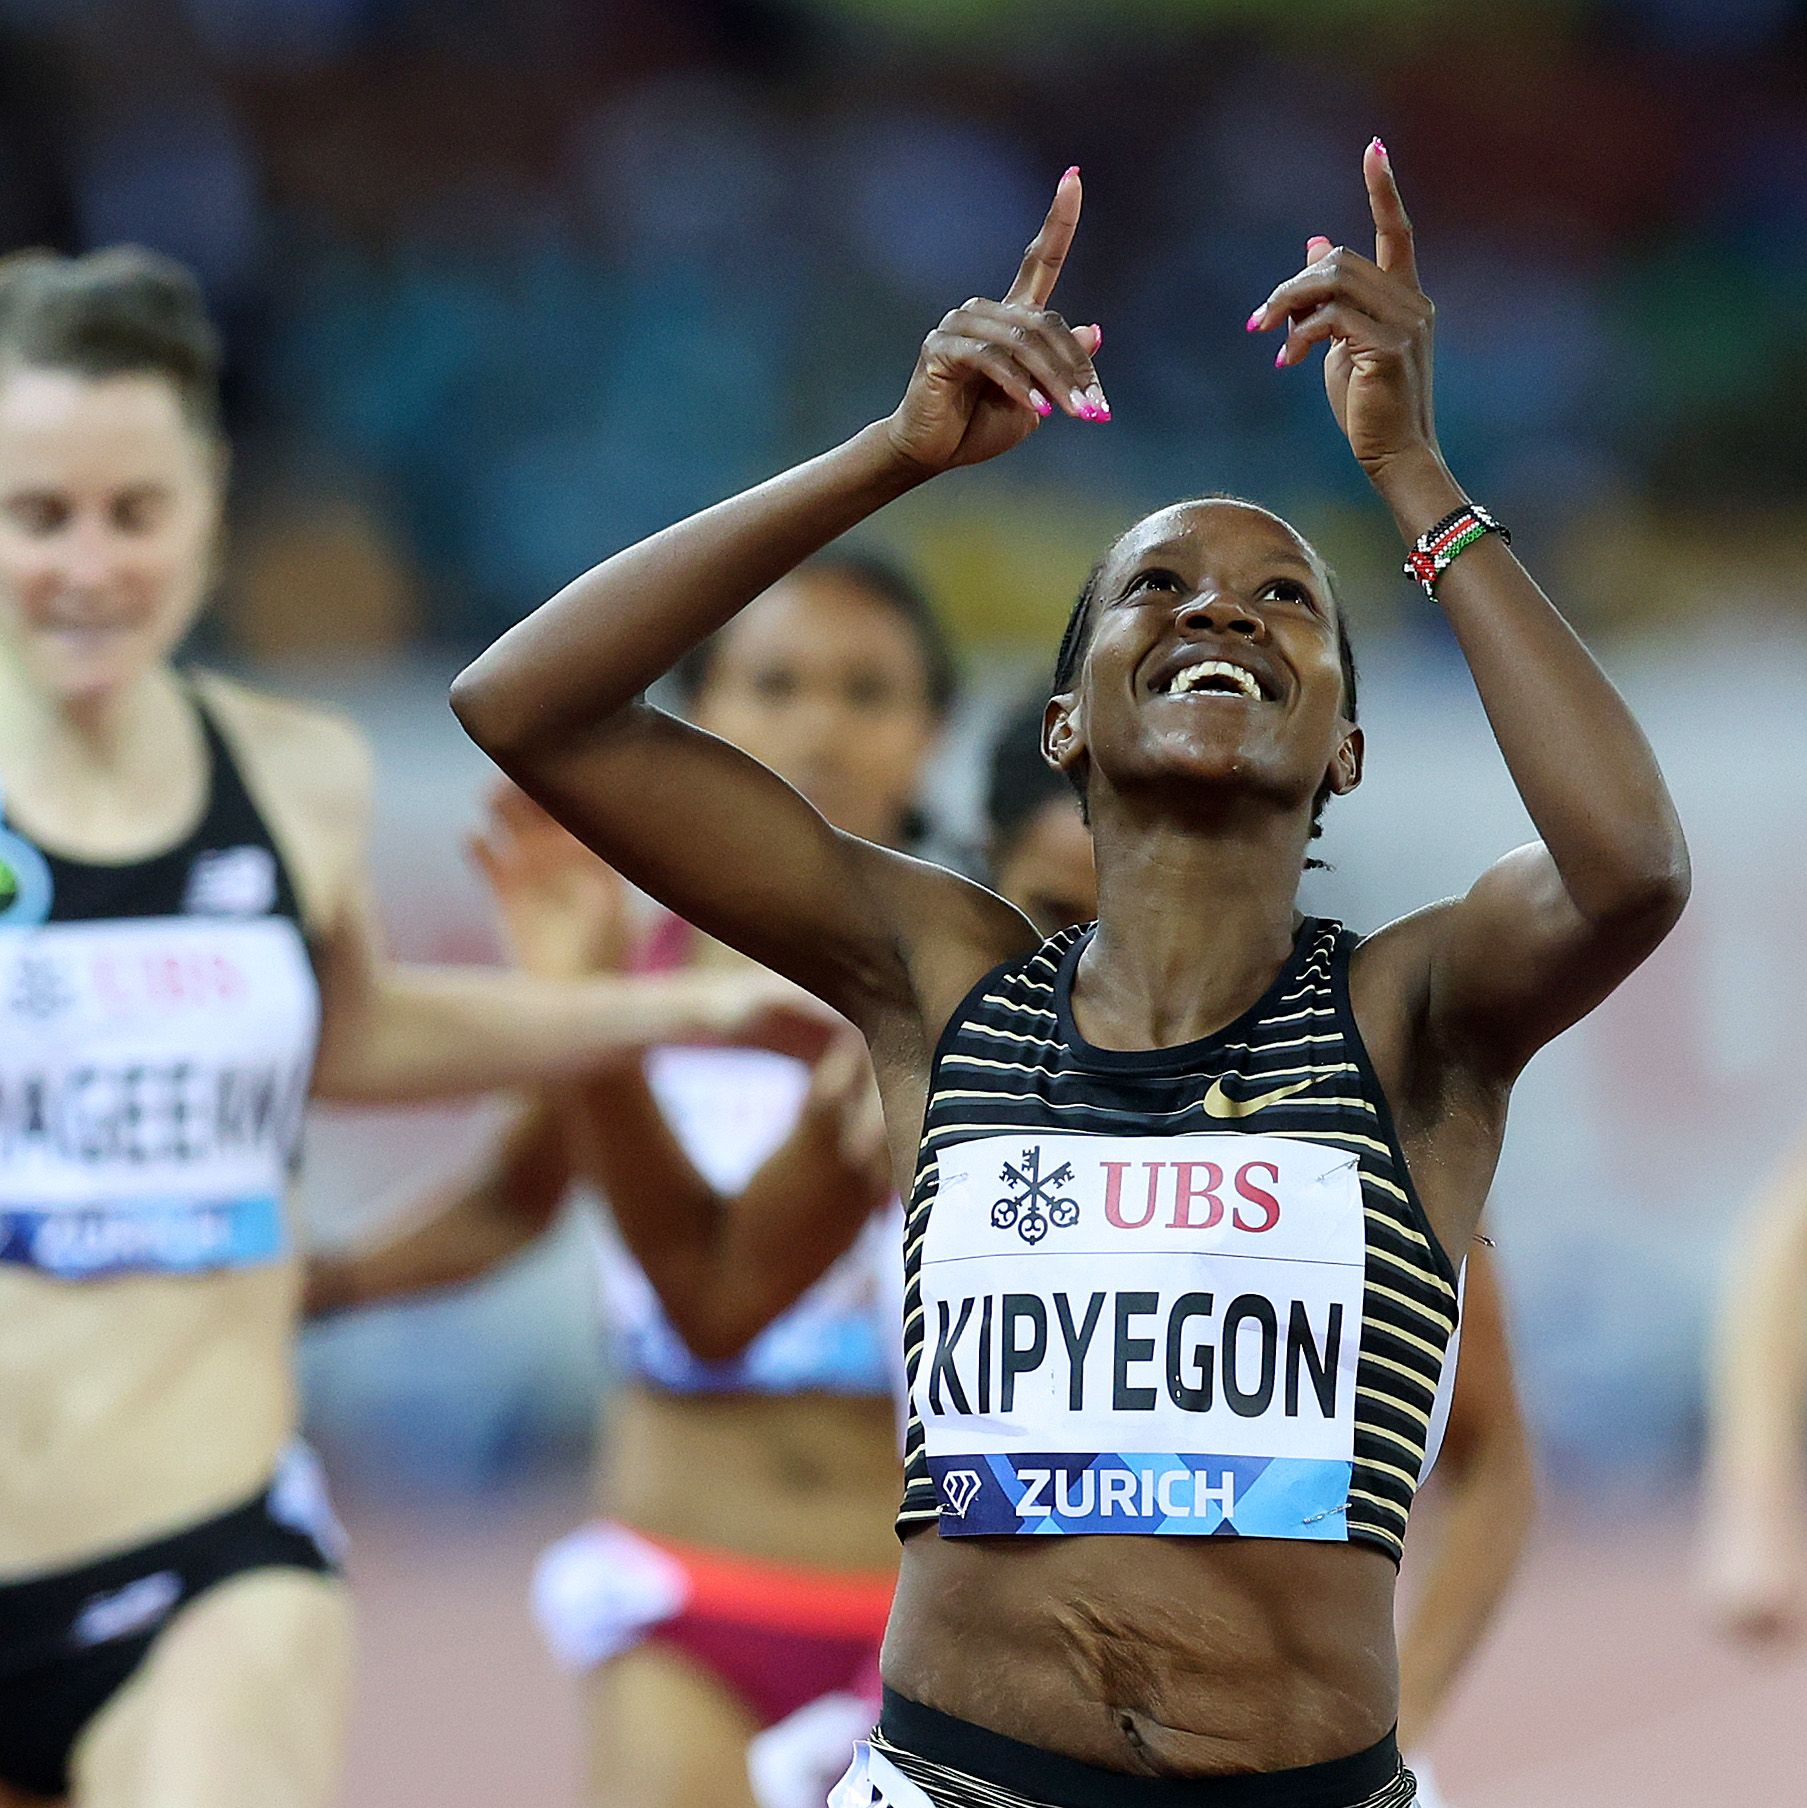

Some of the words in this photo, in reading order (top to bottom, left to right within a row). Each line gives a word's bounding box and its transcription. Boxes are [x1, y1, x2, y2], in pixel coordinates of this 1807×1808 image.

[1098, 1159, 1283, 1234] UBS
[928, 1291, 1344, 1419] KIPYEGON
[1015, 1468, 1234, 1518] ZURICH
